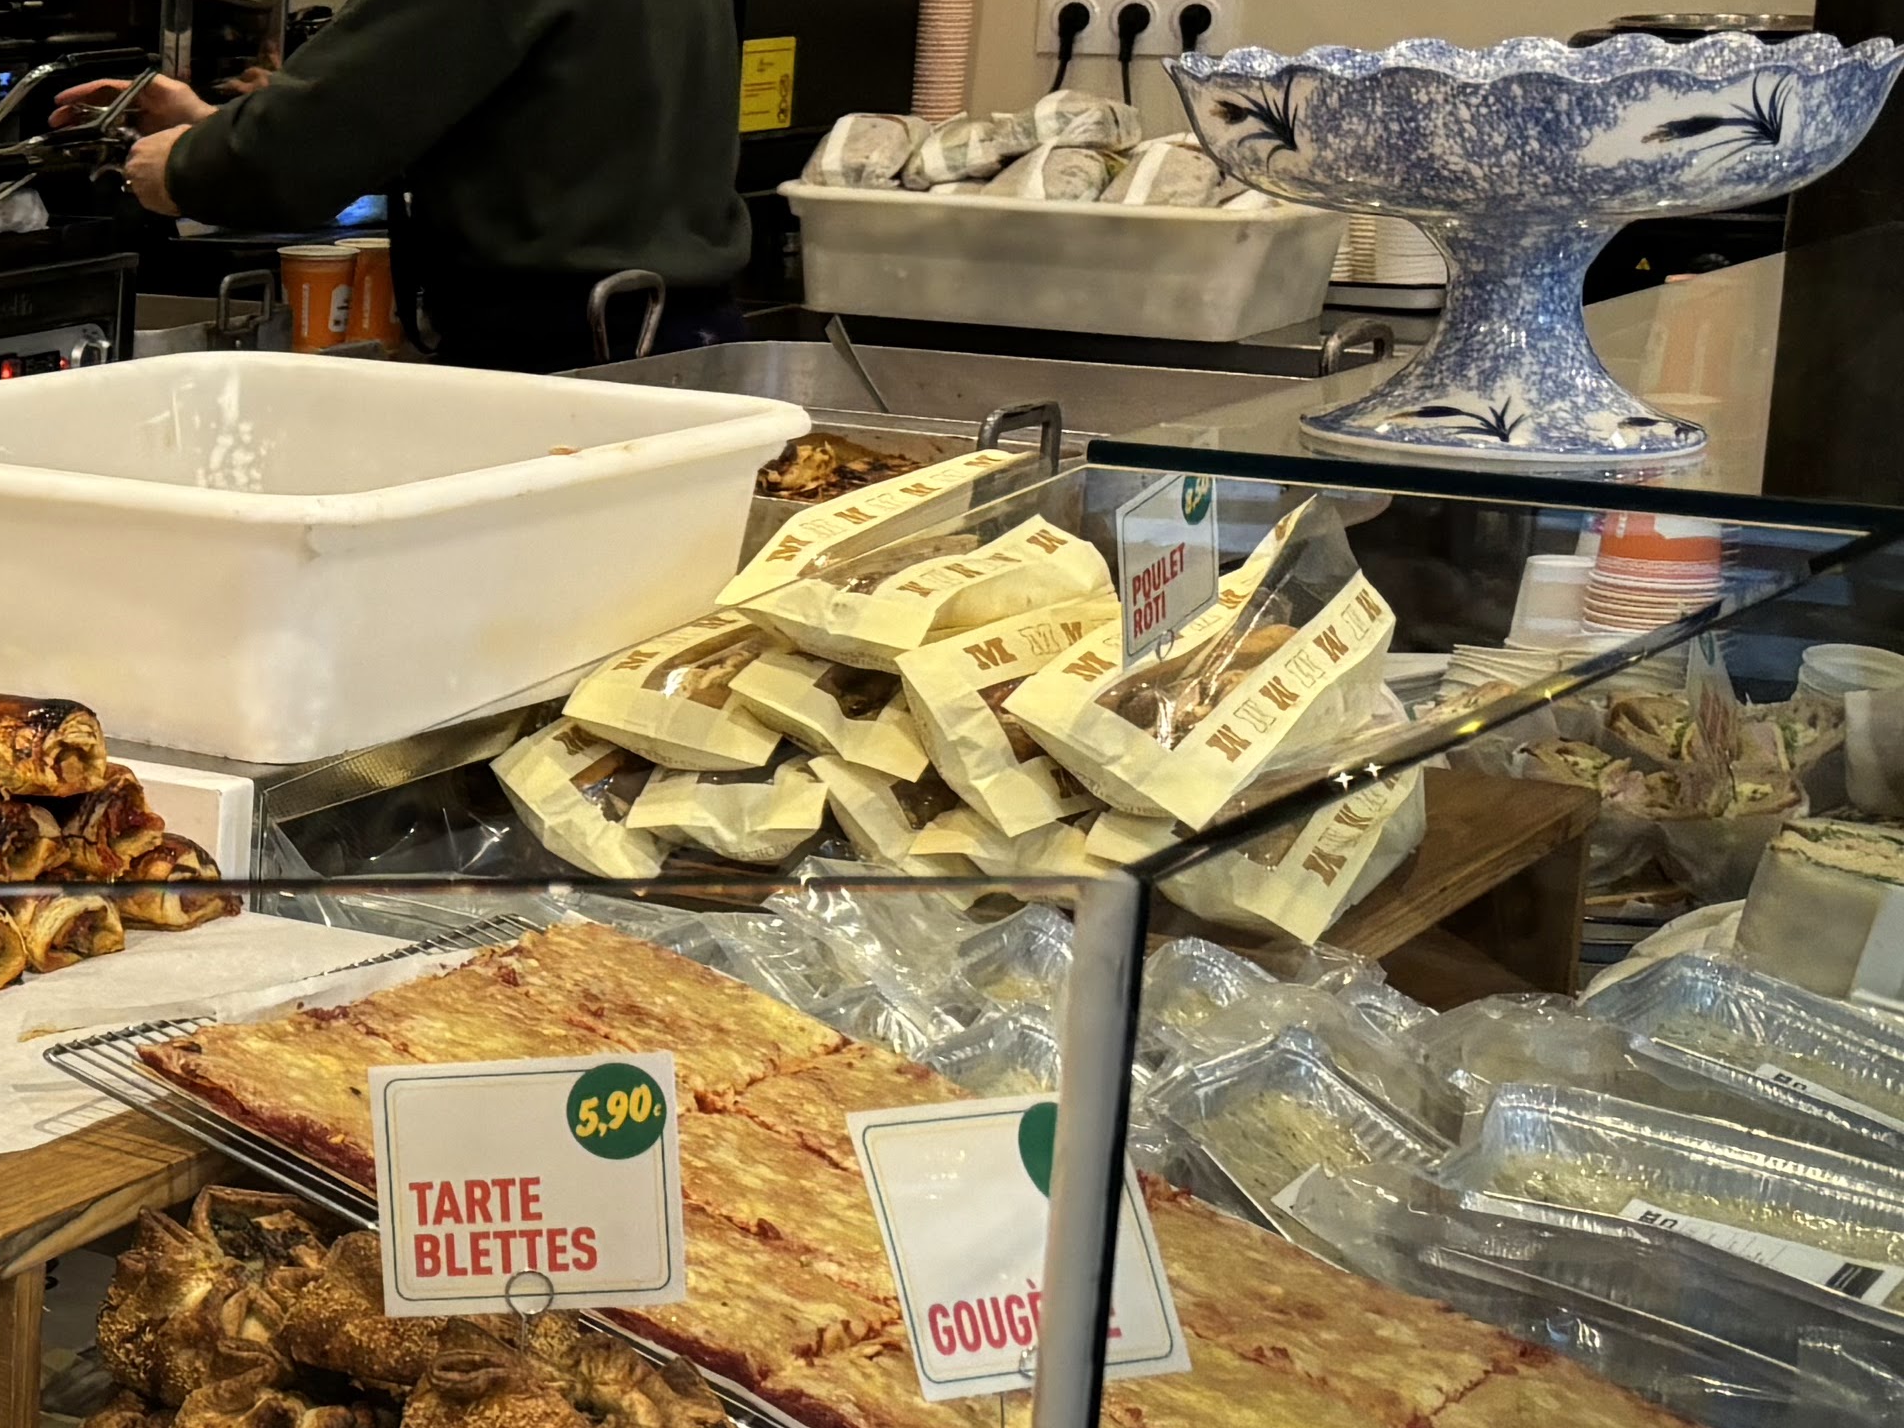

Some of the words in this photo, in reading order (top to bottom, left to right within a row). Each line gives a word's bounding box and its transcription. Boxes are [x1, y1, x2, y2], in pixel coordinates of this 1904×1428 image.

[1132, 541, 1185, 606] POULET
[1133, 591, 1166, 639] ROTI
[963, 637, 1018, 671] M
[408, 1176, 542, 1226] TARTE
[414, 1226, 598, 1278] BLETTES
